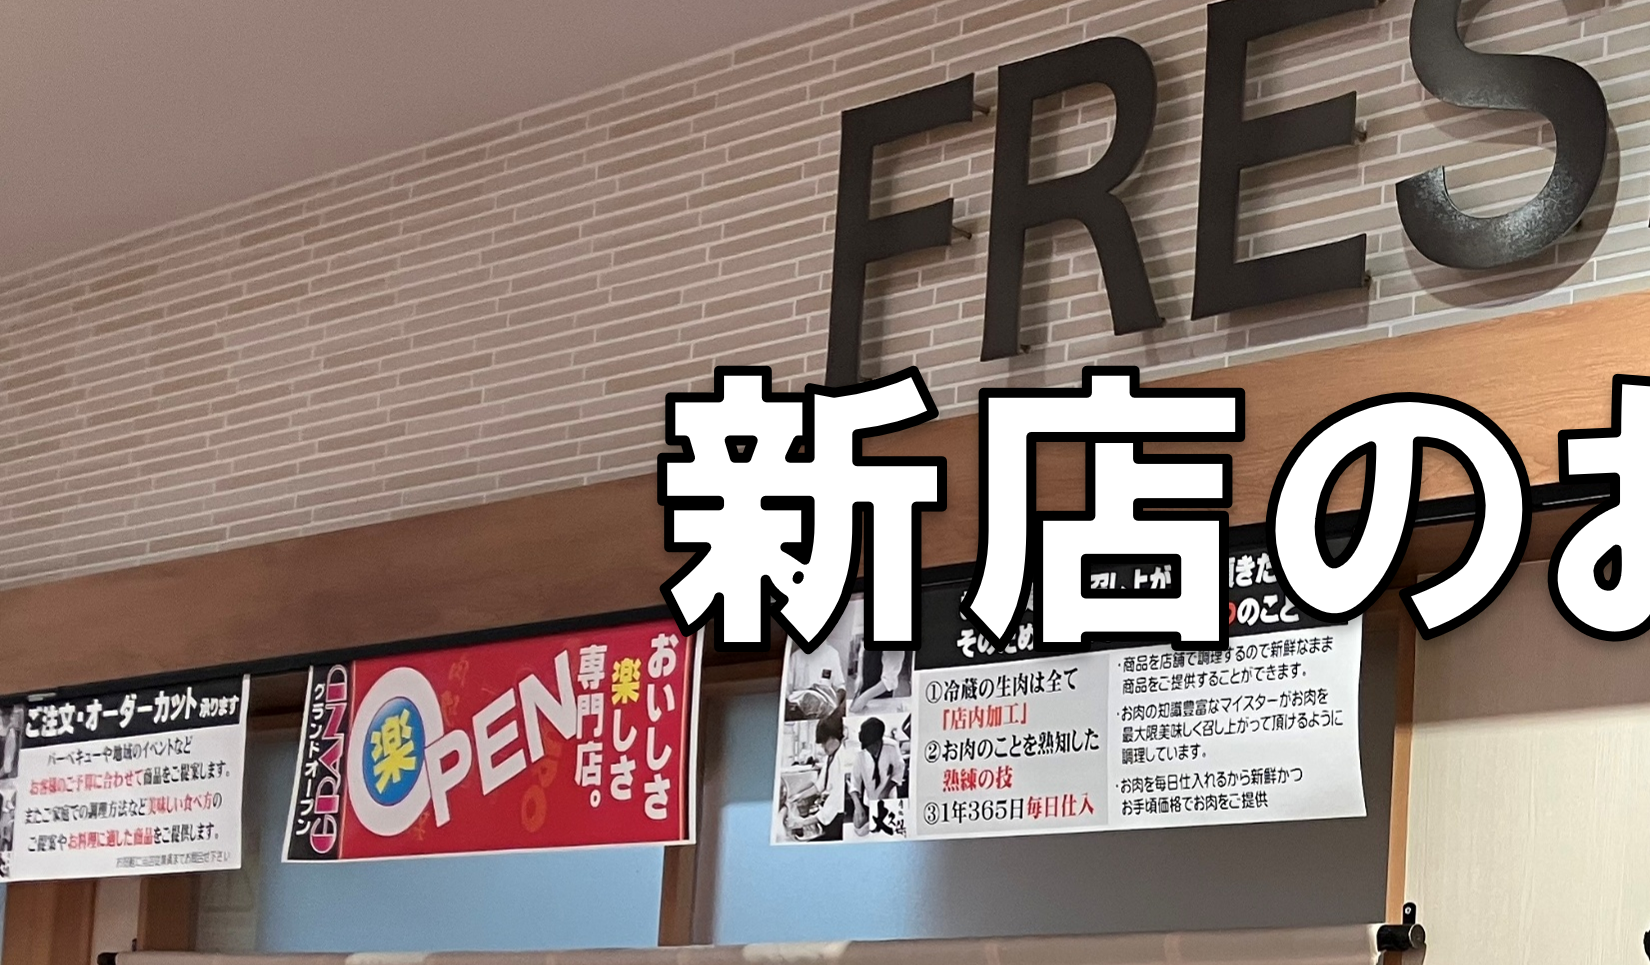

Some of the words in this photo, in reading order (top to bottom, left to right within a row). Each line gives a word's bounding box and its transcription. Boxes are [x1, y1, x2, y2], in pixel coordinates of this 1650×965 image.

[574, 644, 608, 808] 専門店。
[610, 656, 642, 800] 楽しさ
[643, 633, 680, 820] おいしさ
[925, 667, 1079, 703] ①冷蔵の生肉は全て
[296, 682, 326, 836] グランドオープン
[310, 664, 348, 853] GRAND
[348, 650, 578, 837] OPEN
[371, 709, 416, 794] 楽
[924, 728, 1100, 763] ②お肉のことを熟知した
[942, 765, 1013, 793] 熟練の技
[1122, 743, 1207, 765] 調理しています。
[1121, 791, 1269, 816] お手頃価格でお肉をご提供
